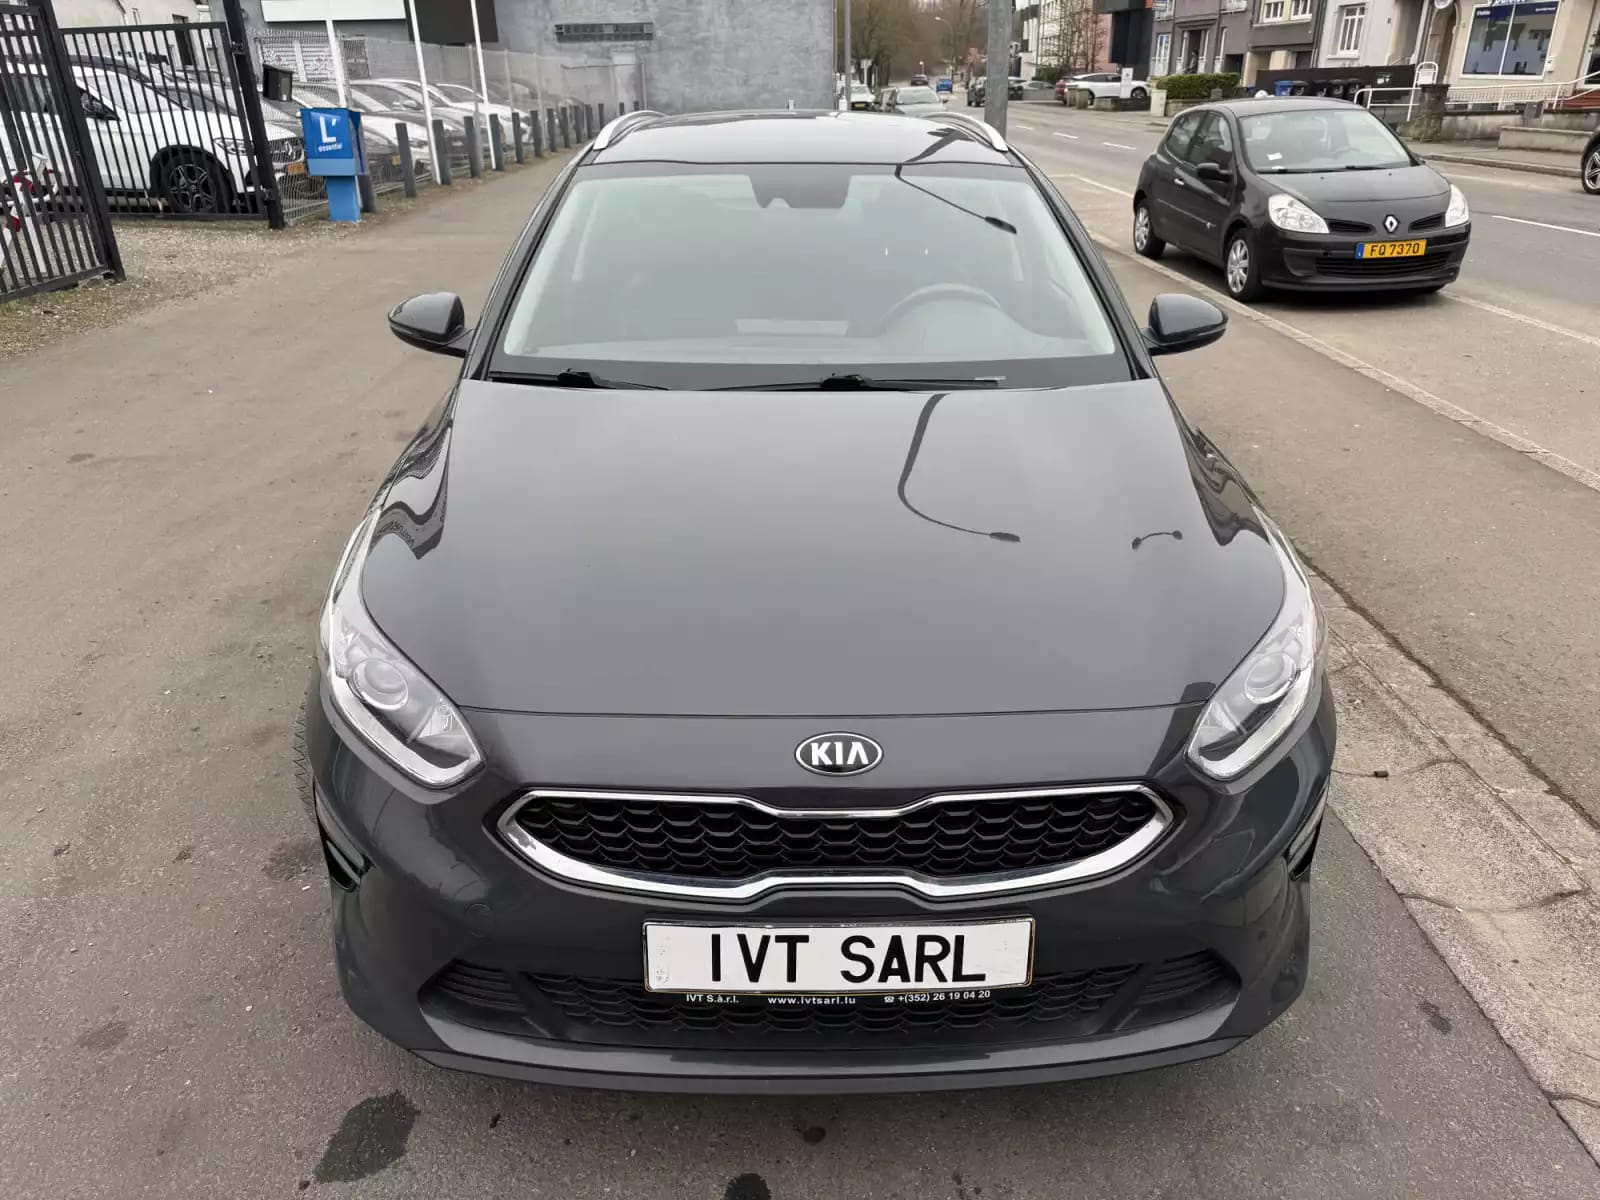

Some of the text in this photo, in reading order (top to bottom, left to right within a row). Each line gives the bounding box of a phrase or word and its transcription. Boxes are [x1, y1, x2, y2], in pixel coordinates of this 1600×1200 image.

[1370, 244, 1386, 257] FQ
[1389, 243, 1420, 256] 7370
[810, 741, 869, 766] KIA
[711, 933, 987, 983] IVT SARL
[686, 994, 704, 1002] IVT
[767, 996, 856, 1005] www.ivtsarl.lu
[898, 994, 930, 1003] +(352)
[932, 993, 945, 1001] 26
[949, 992, 961, 1000] 19
[963, 991, 976, 999] 04
[978, 990, 991, 998] 20
